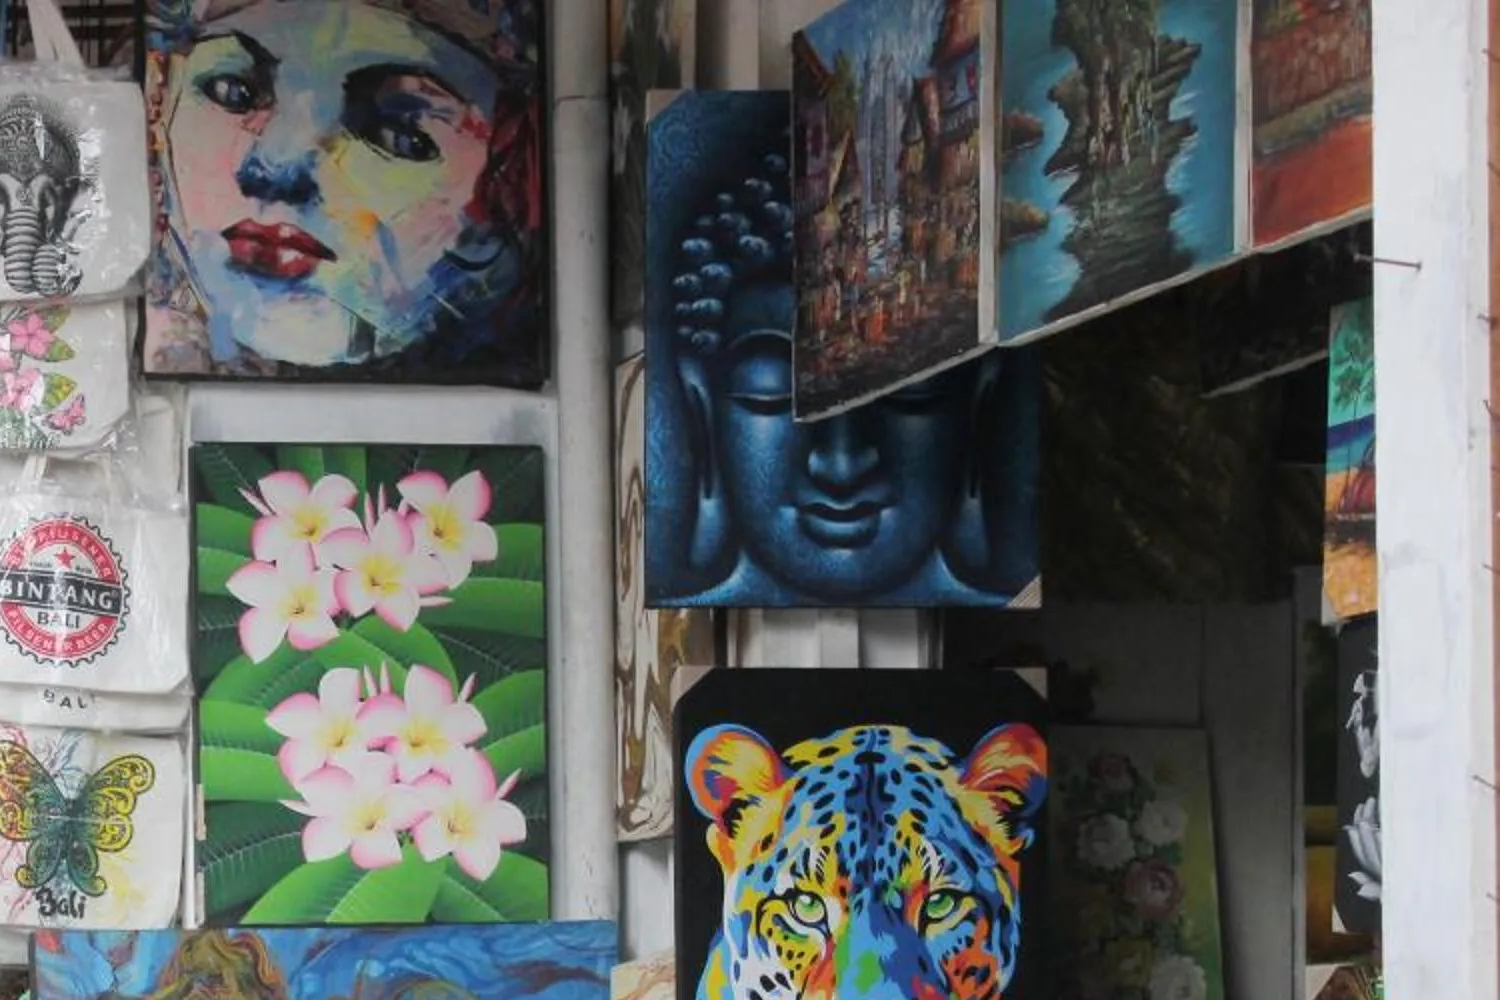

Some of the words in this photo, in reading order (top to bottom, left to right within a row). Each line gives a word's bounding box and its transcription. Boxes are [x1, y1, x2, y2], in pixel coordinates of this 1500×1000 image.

[7, 609, 74, 651] PILSENR
[37, 611, 80, 629] BALI
[35, 887, 87, 919] Bali
